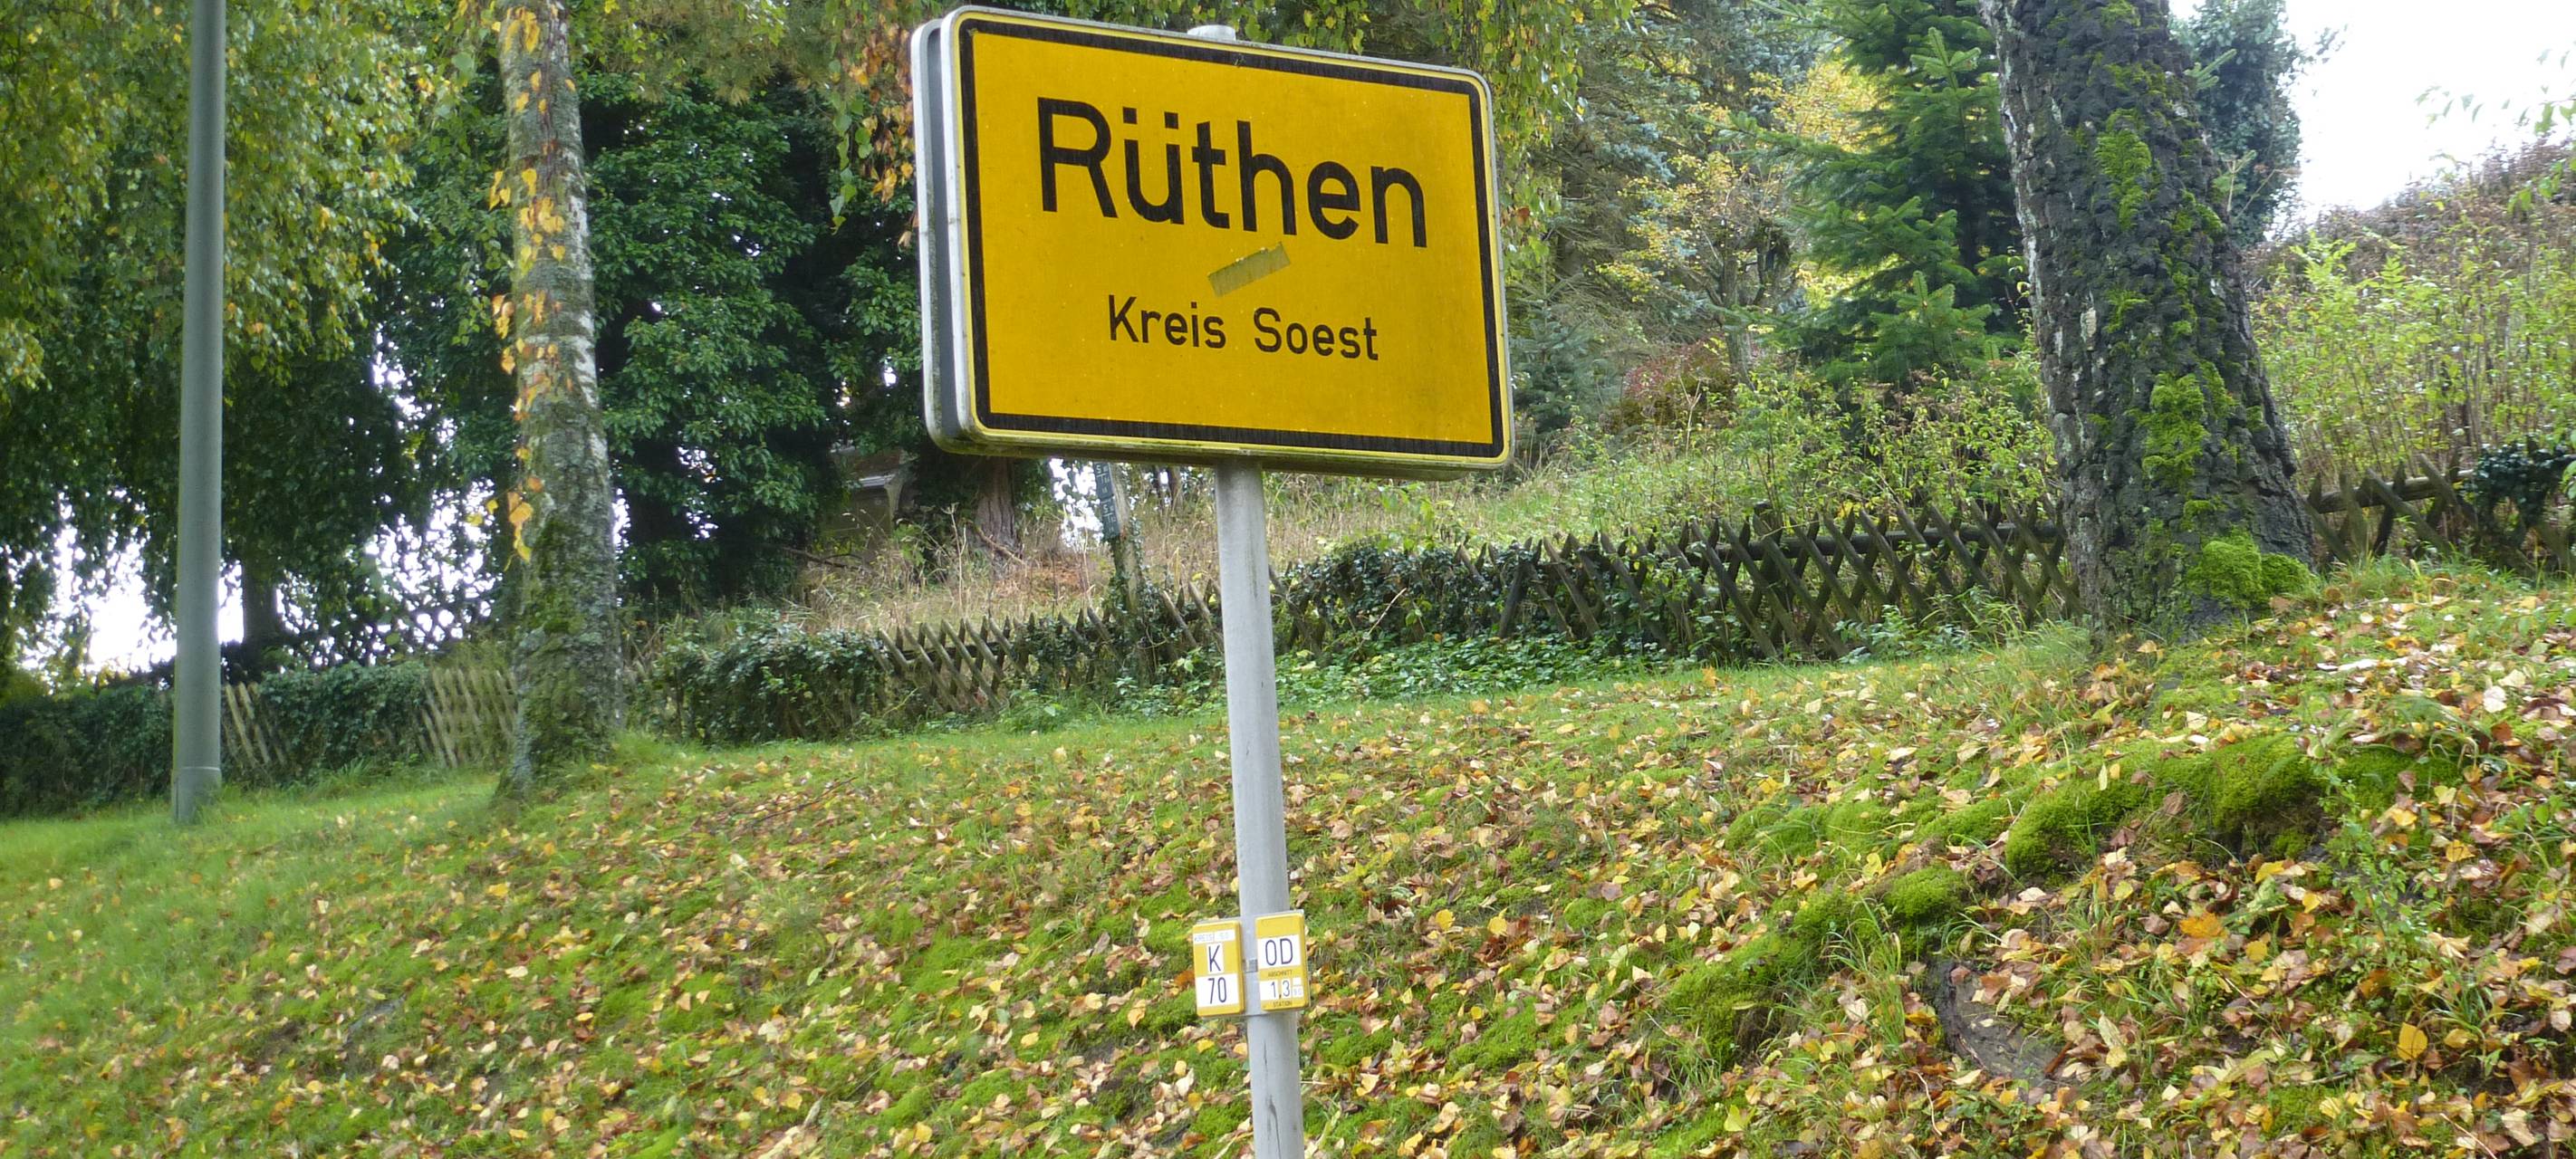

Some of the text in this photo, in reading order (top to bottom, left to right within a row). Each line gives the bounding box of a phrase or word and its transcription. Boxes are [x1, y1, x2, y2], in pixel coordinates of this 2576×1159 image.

[1037, 96, 1427, 248] Rüthen
[1108, 294, 1379, 361] Kreis Soest
[1208, 944, 1221, 972] K
[1265, 938, 1293, 966] OD
[1208, 977, 1227, 1004] 70
